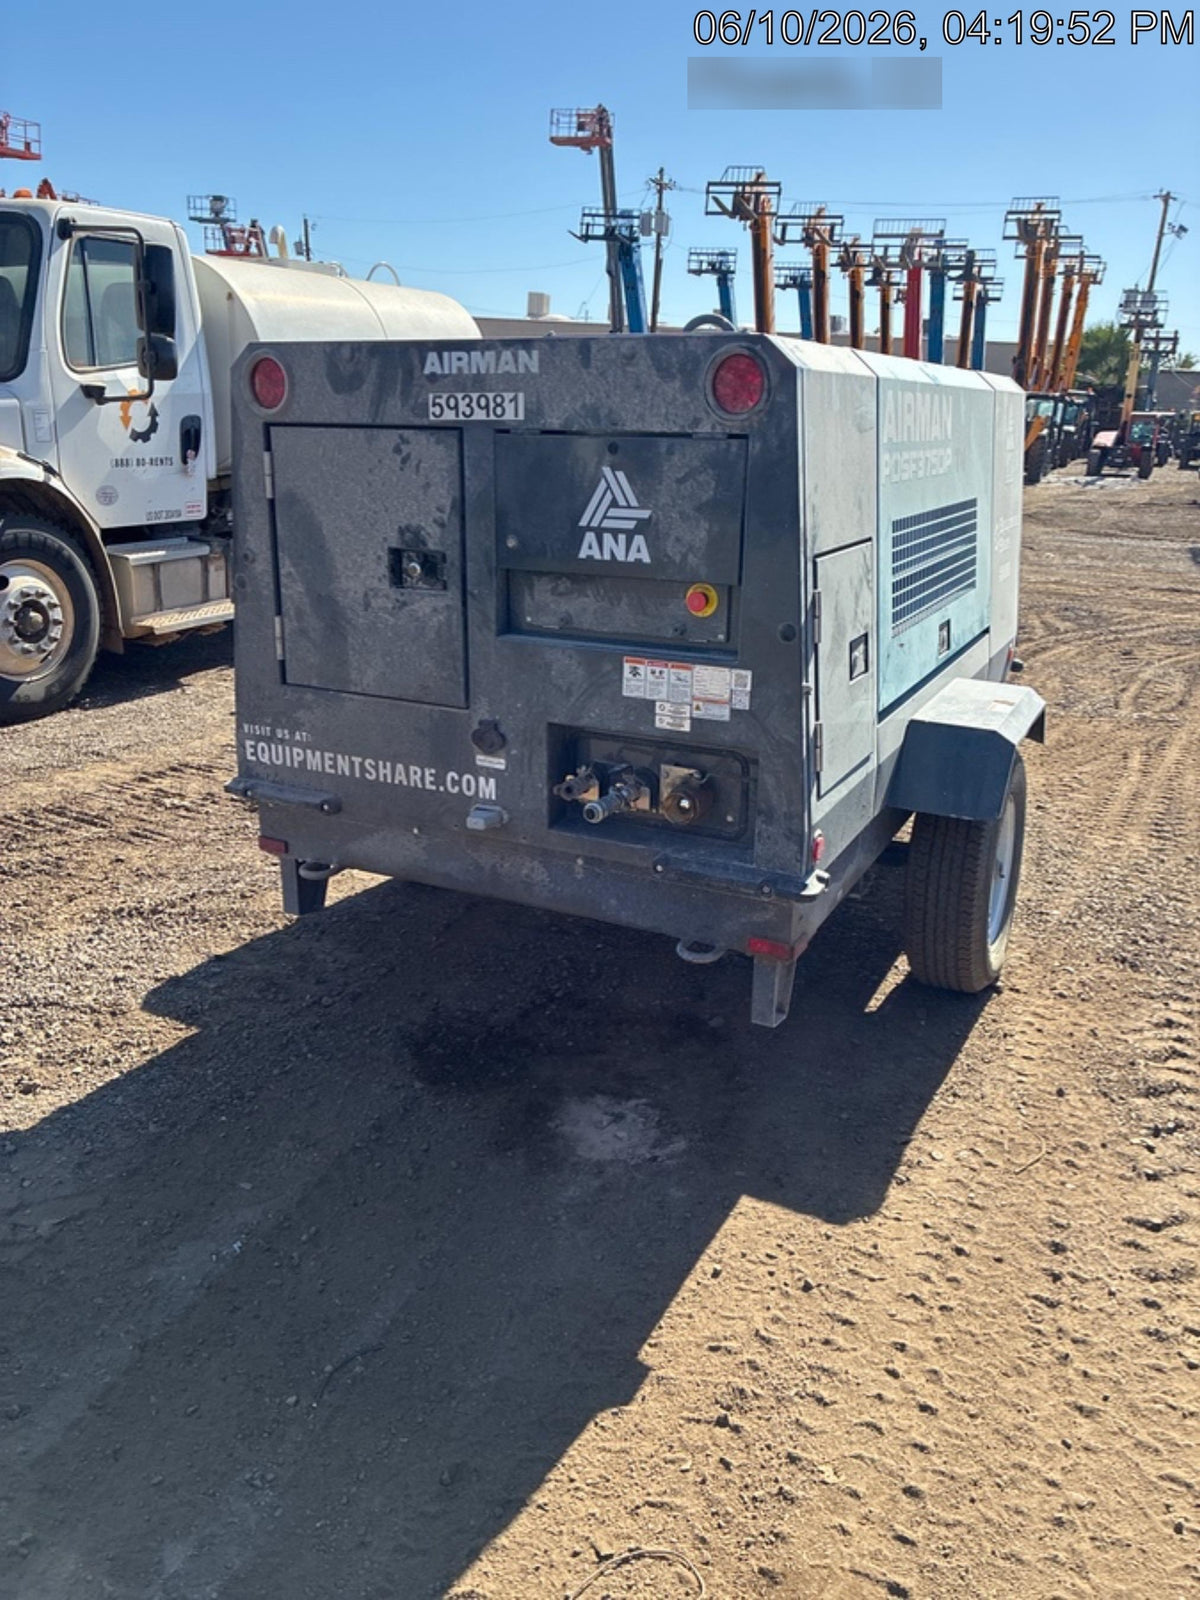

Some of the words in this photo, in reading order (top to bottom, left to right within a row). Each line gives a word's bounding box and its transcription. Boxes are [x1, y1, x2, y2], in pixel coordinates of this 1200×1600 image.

[423, 350, 539, 375] AIRMAN
[431, 393, 519, 419] 593981
[882, 389, 952, 443] AIRMAN
[578, 531, 651, 564] ANA
[243, 723, 272, 737] VISIT
[276, 728, 291, 741] US
[294, 730, 312, 743] AT:
[244, 739, 498, 801] EQUIPMENTSHARE.COM
